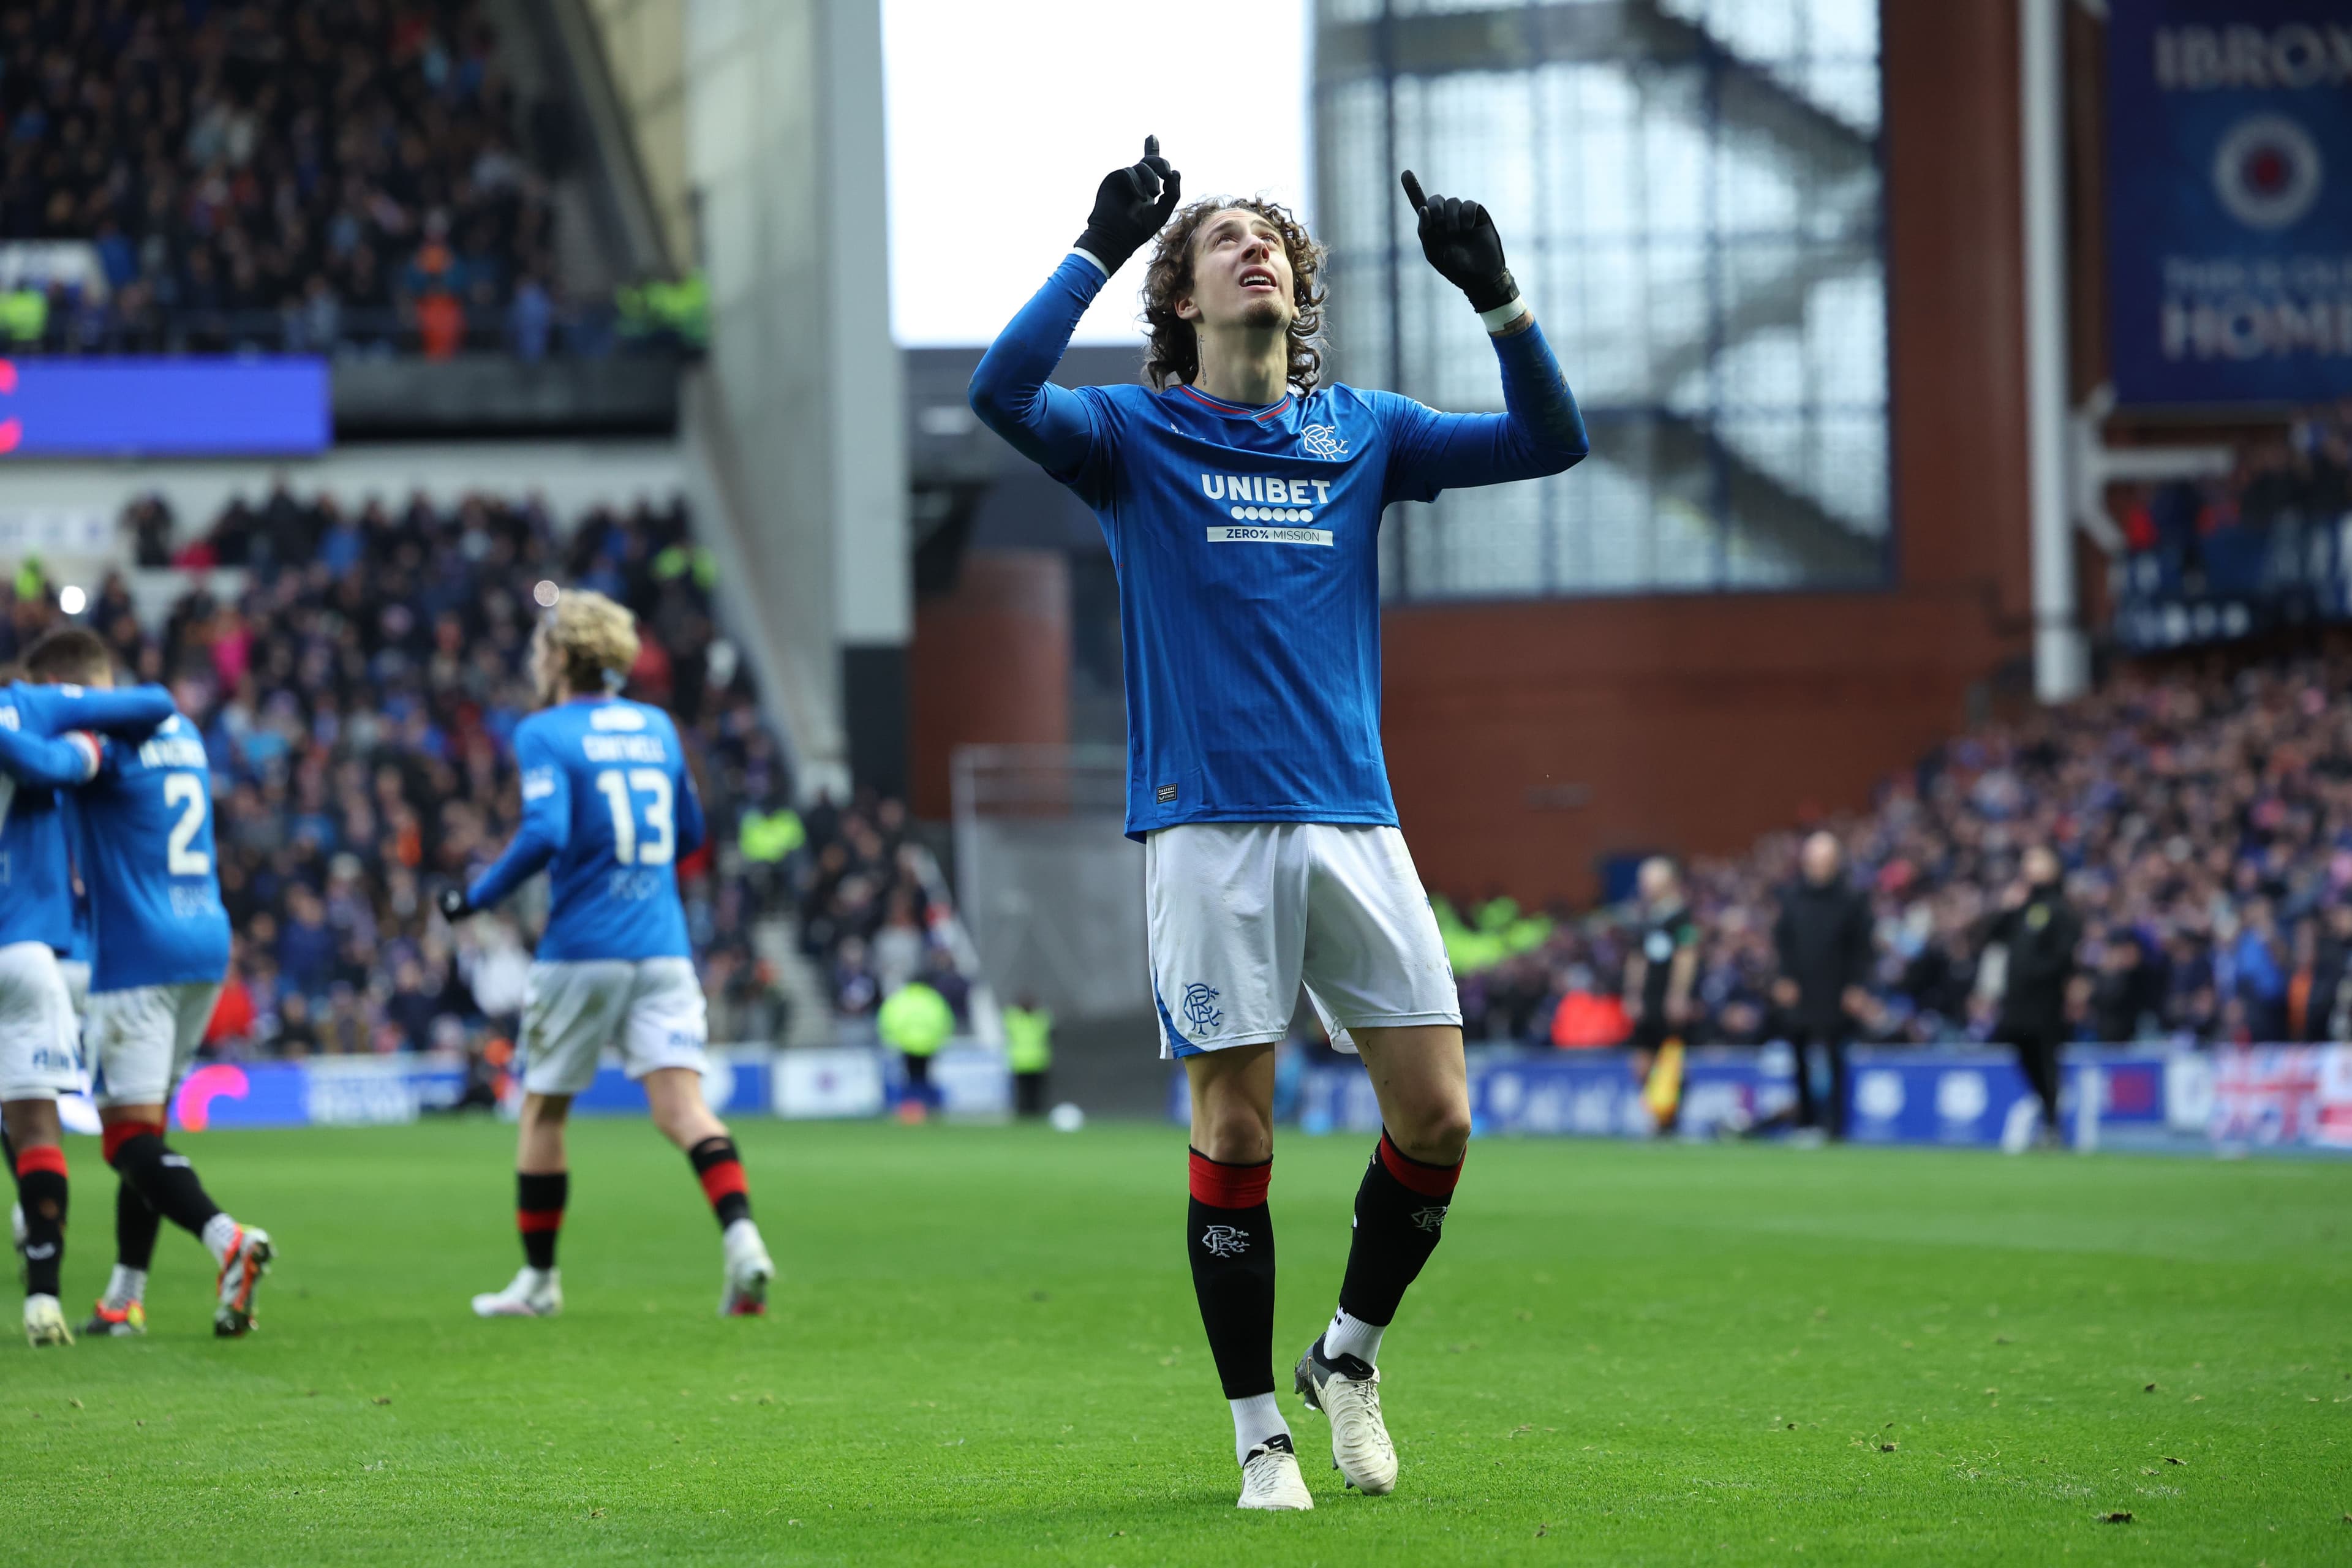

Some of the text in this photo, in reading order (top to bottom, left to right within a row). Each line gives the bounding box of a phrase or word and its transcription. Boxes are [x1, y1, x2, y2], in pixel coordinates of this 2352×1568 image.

[1202, 474, 1330, 504] UNIBET
[1226, 529, 1319, 542] ZERO% MISSION
[164, 772, 210, 876] 2
[596, 767, 675, 865] 13
